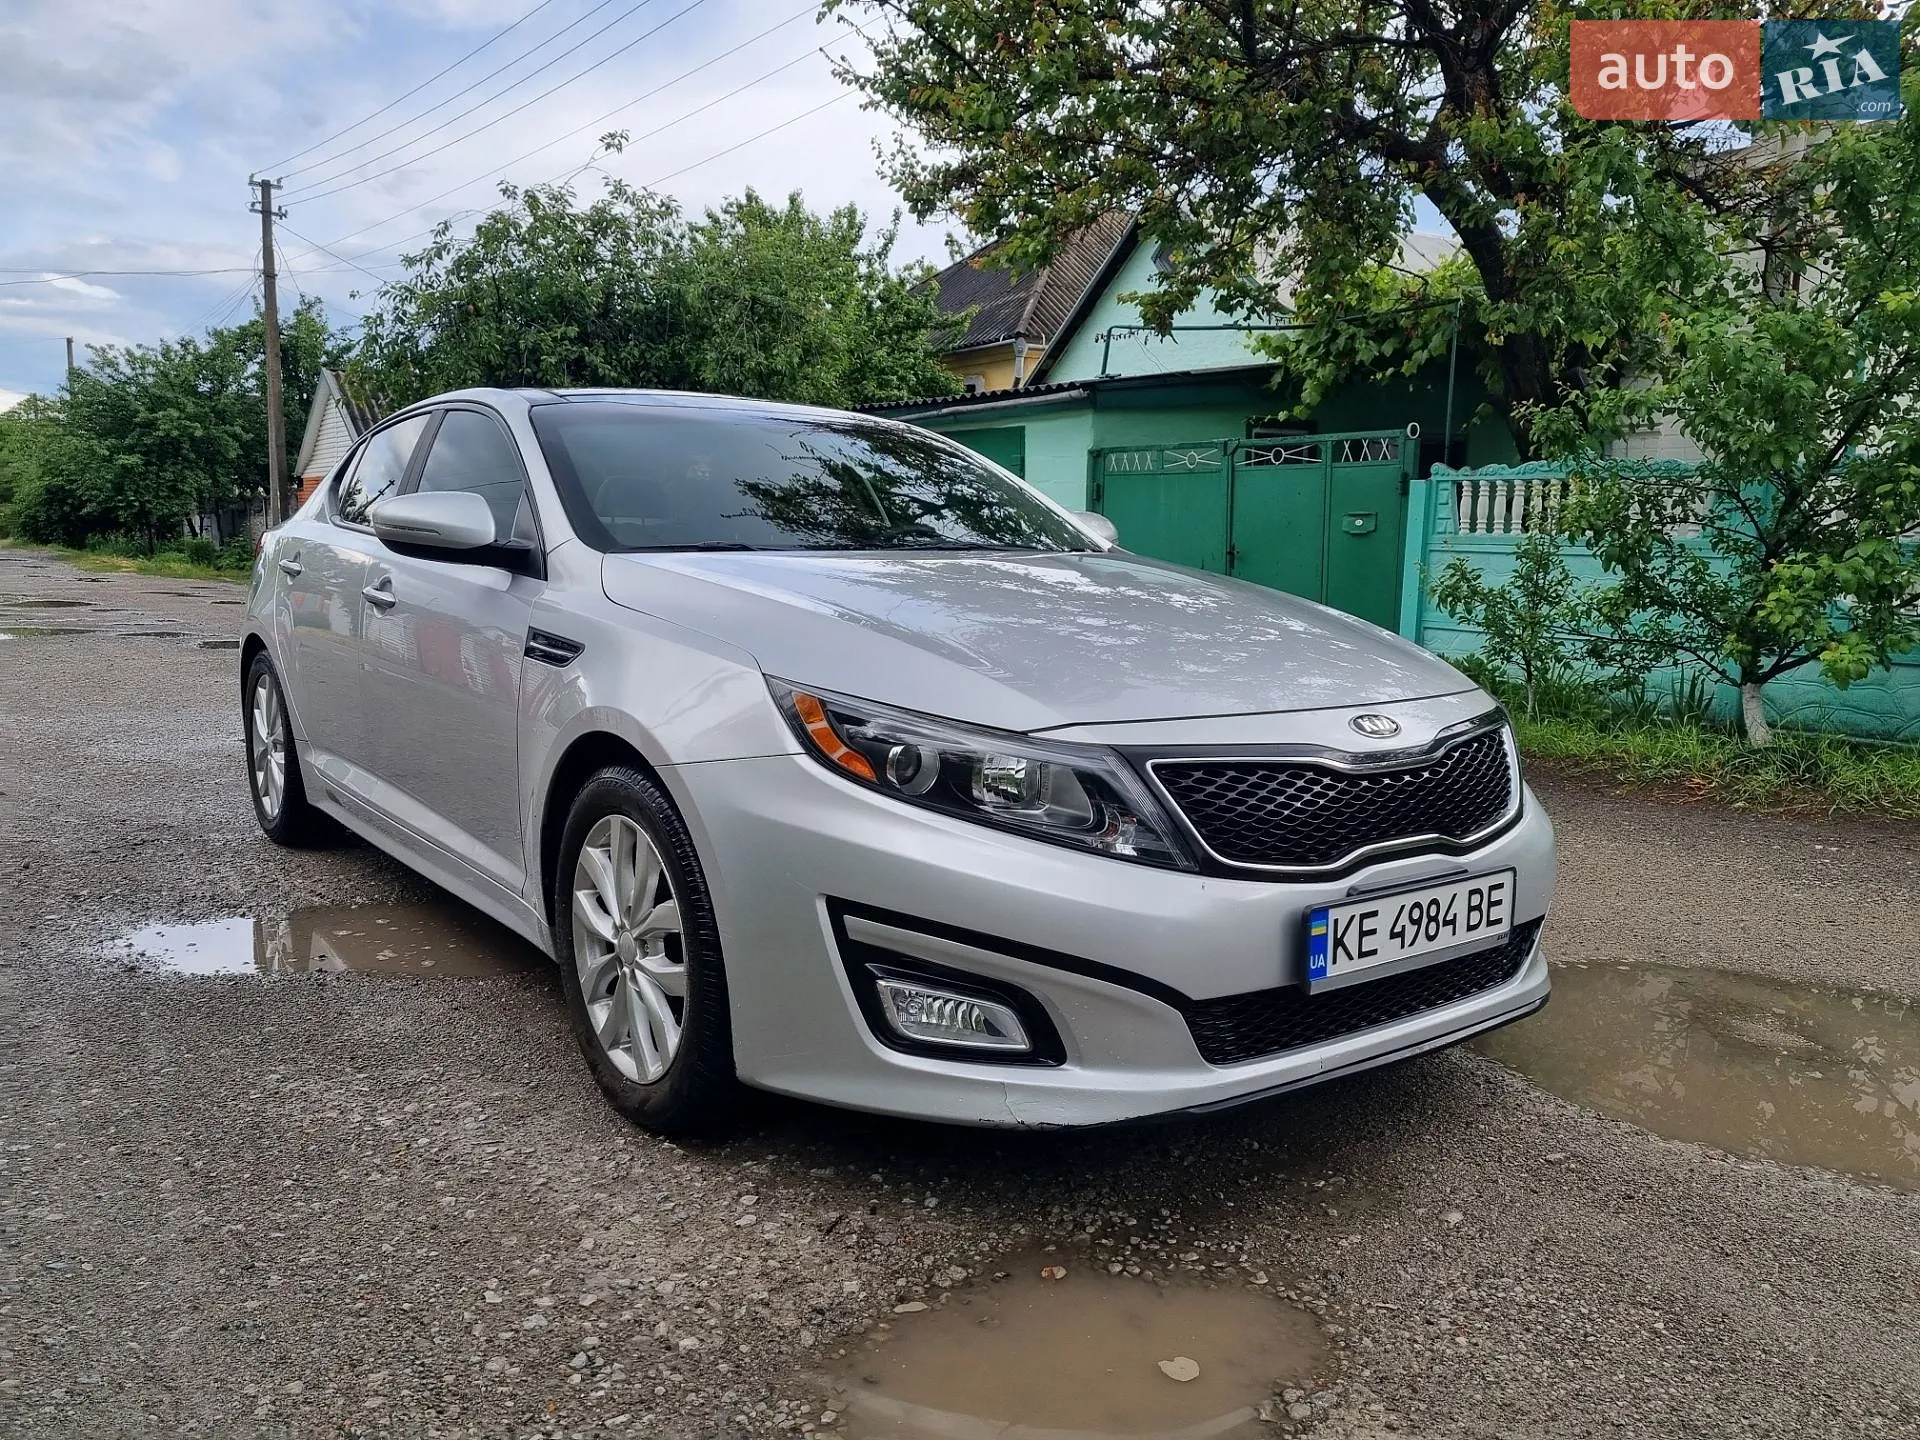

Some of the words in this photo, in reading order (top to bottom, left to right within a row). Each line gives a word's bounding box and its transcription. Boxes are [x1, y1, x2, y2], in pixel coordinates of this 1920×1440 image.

[1355, 716, 1397, 733] KIA
[1332, 908, 1379, 966] KE
[1389, 892, 1459, 950] 4984
[1466, 882, 1505, 933] BE
[1309, 953, 1326, 970] UA
